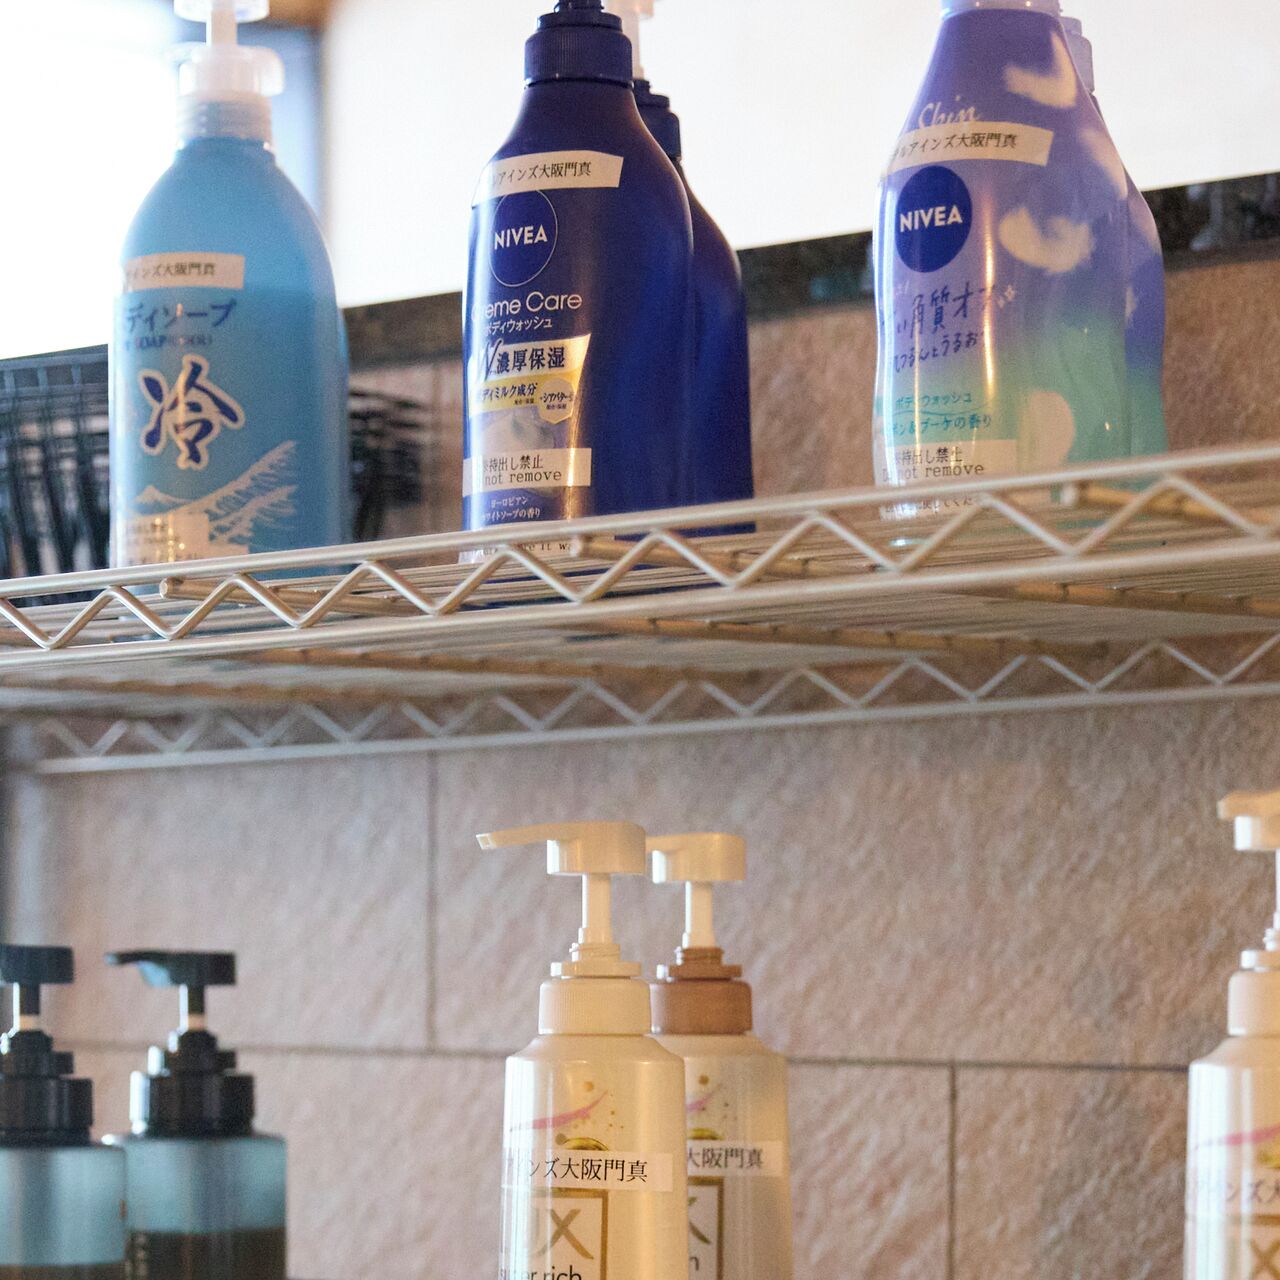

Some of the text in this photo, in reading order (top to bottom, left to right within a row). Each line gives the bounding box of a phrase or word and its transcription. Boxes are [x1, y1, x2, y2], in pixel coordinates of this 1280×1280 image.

[899, 205, 963, 233] NIVEA
[494, 224, 548, 250] NIVEA
[525, 291, 583, 313] Care
[141, 356, 246, 470] 冷
[509, 470, 562, 484] remove
[925, 463, 984, 478] remove
